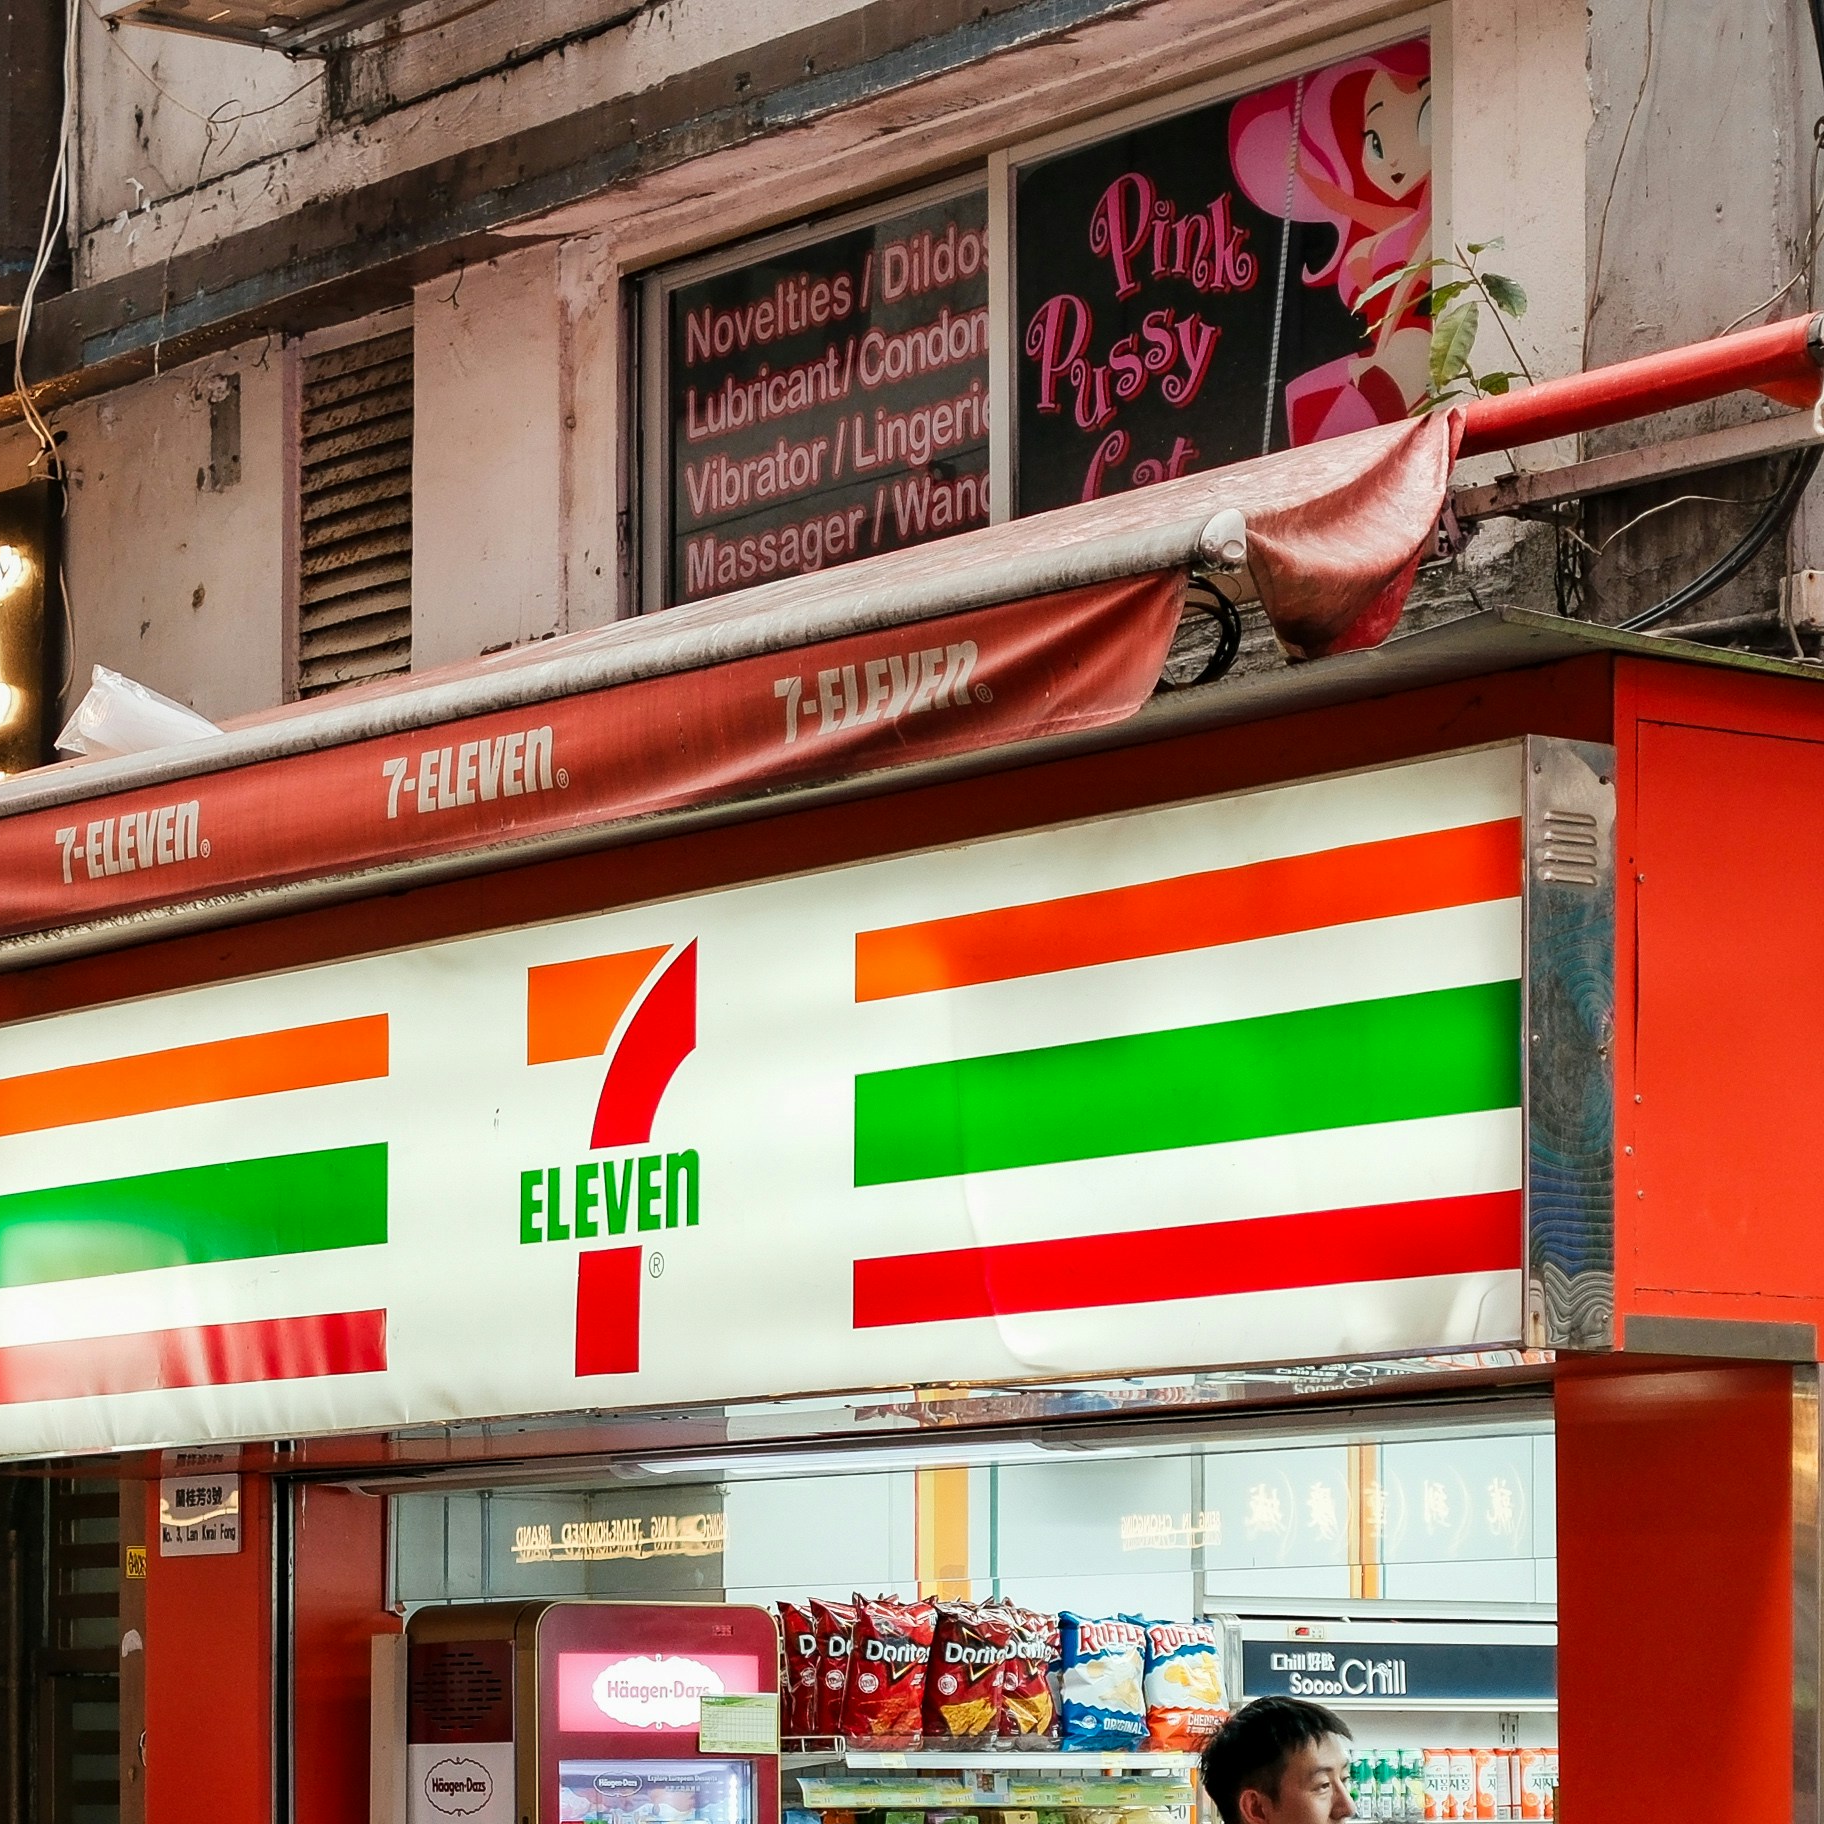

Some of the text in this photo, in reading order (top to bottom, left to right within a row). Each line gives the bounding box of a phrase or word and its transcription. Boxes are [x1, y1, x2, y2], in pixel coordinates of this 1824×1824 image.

[1090, 172, 1258, 299] Pink
[687, 273, 853, 364] Novelties
[1026, 294, 1222, 429] Pussy
[688, 346, 841, 440] Lubricant
[687, 438, 828, 517] Vibrator
[687, 507, 865, 592] Massager
[527, 936, 699, 1377] 7
[163, 1527, 173, 1542] No.
[187, 1526, 199, 1541] Lan
[202, 1524, 216, 1540] Kwai
[220, 1524, 236, 1541] Fong
